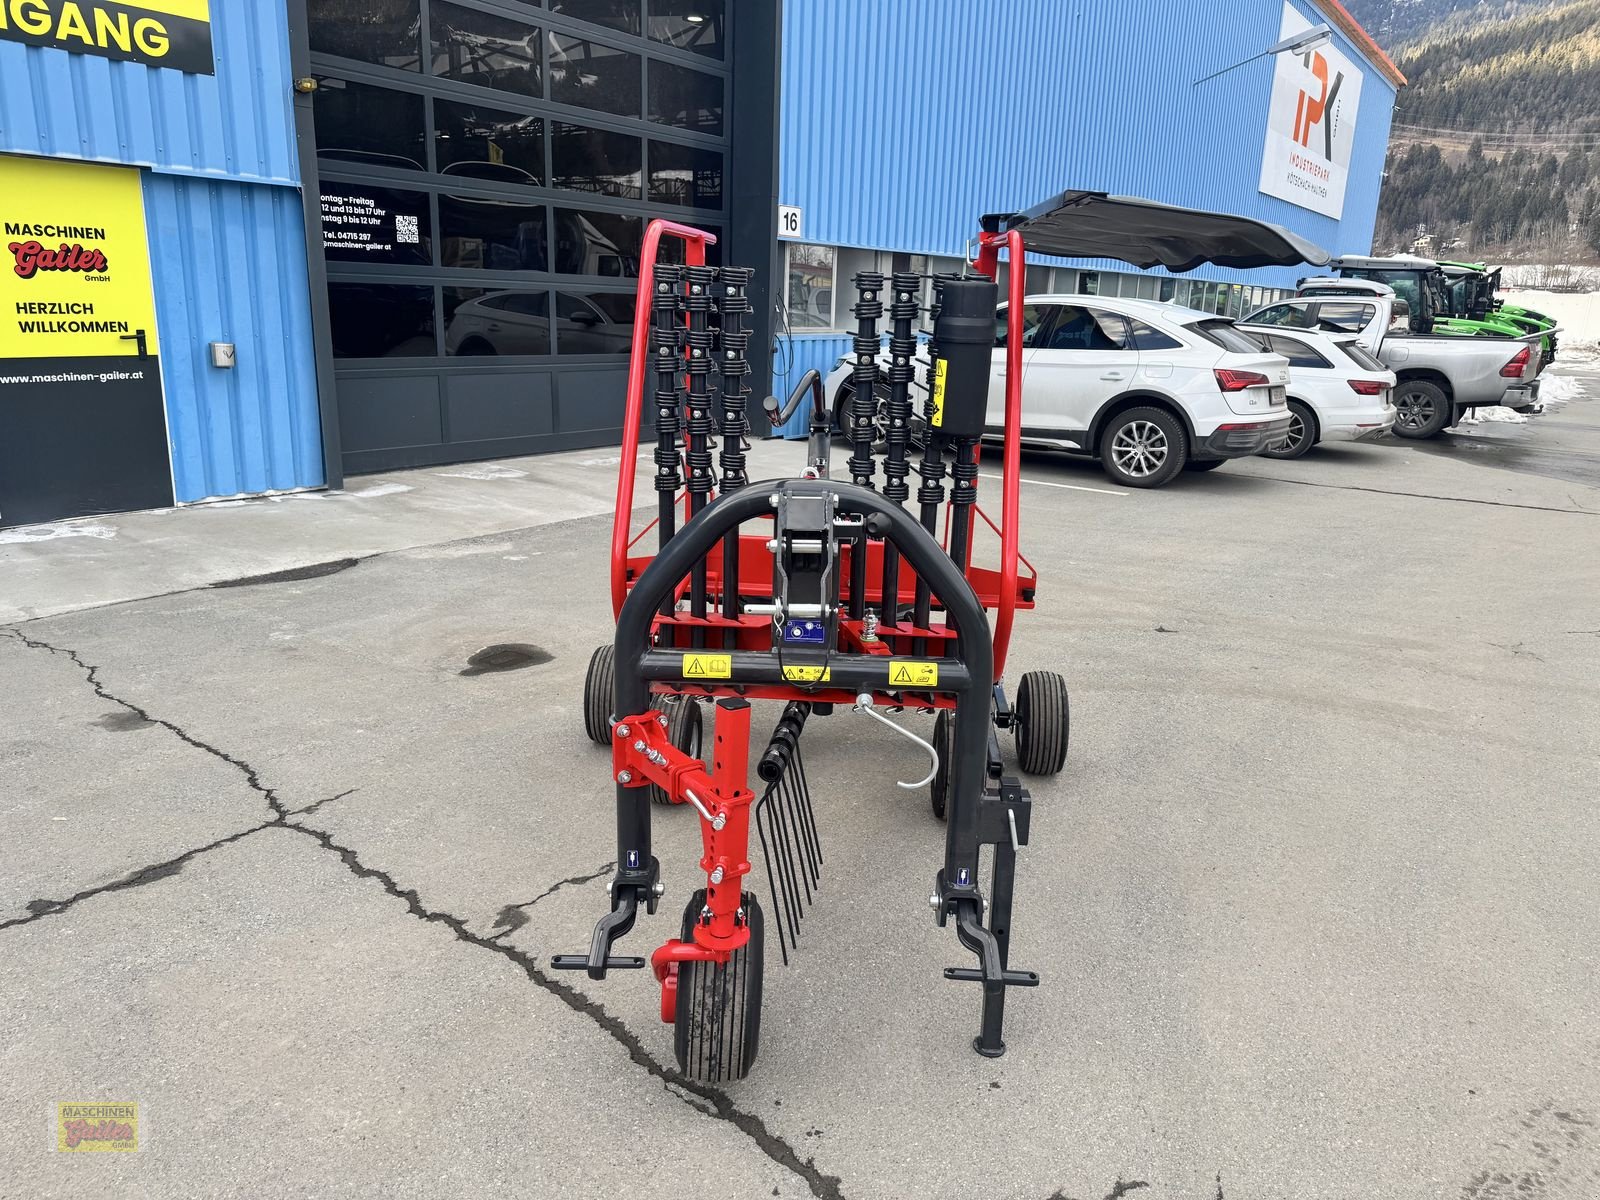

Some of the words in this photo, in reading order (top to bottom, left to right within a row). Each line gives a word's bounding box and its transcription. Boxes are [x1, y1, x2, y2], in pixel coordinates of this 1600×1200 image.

[0, 0, 170, 57] GANG
[1289, 151, 1330, 182] INDUSTRIEPARK
[320, 195, 343, 204] ontag
[349, 196, 374, 207] Freitag
[330, 205, 344, 213] und
[345, 205, 353, 215] 13
[373, 208, 385, 216] Uhr
[783, 211, 798, 232] 16
[5, 222, 105, 240] MASCHINEN
[323, 231, 337, 239] Tel.
[337, 232, 358, 240] 04715
[8, 240, 108, 279] Gailer
[16, 302, 94, 315] HERZLICH
[18, 321, 129, 333] WILLKOMMEN
[0, 370, 144, 384] www.maschinen-gailer.at
